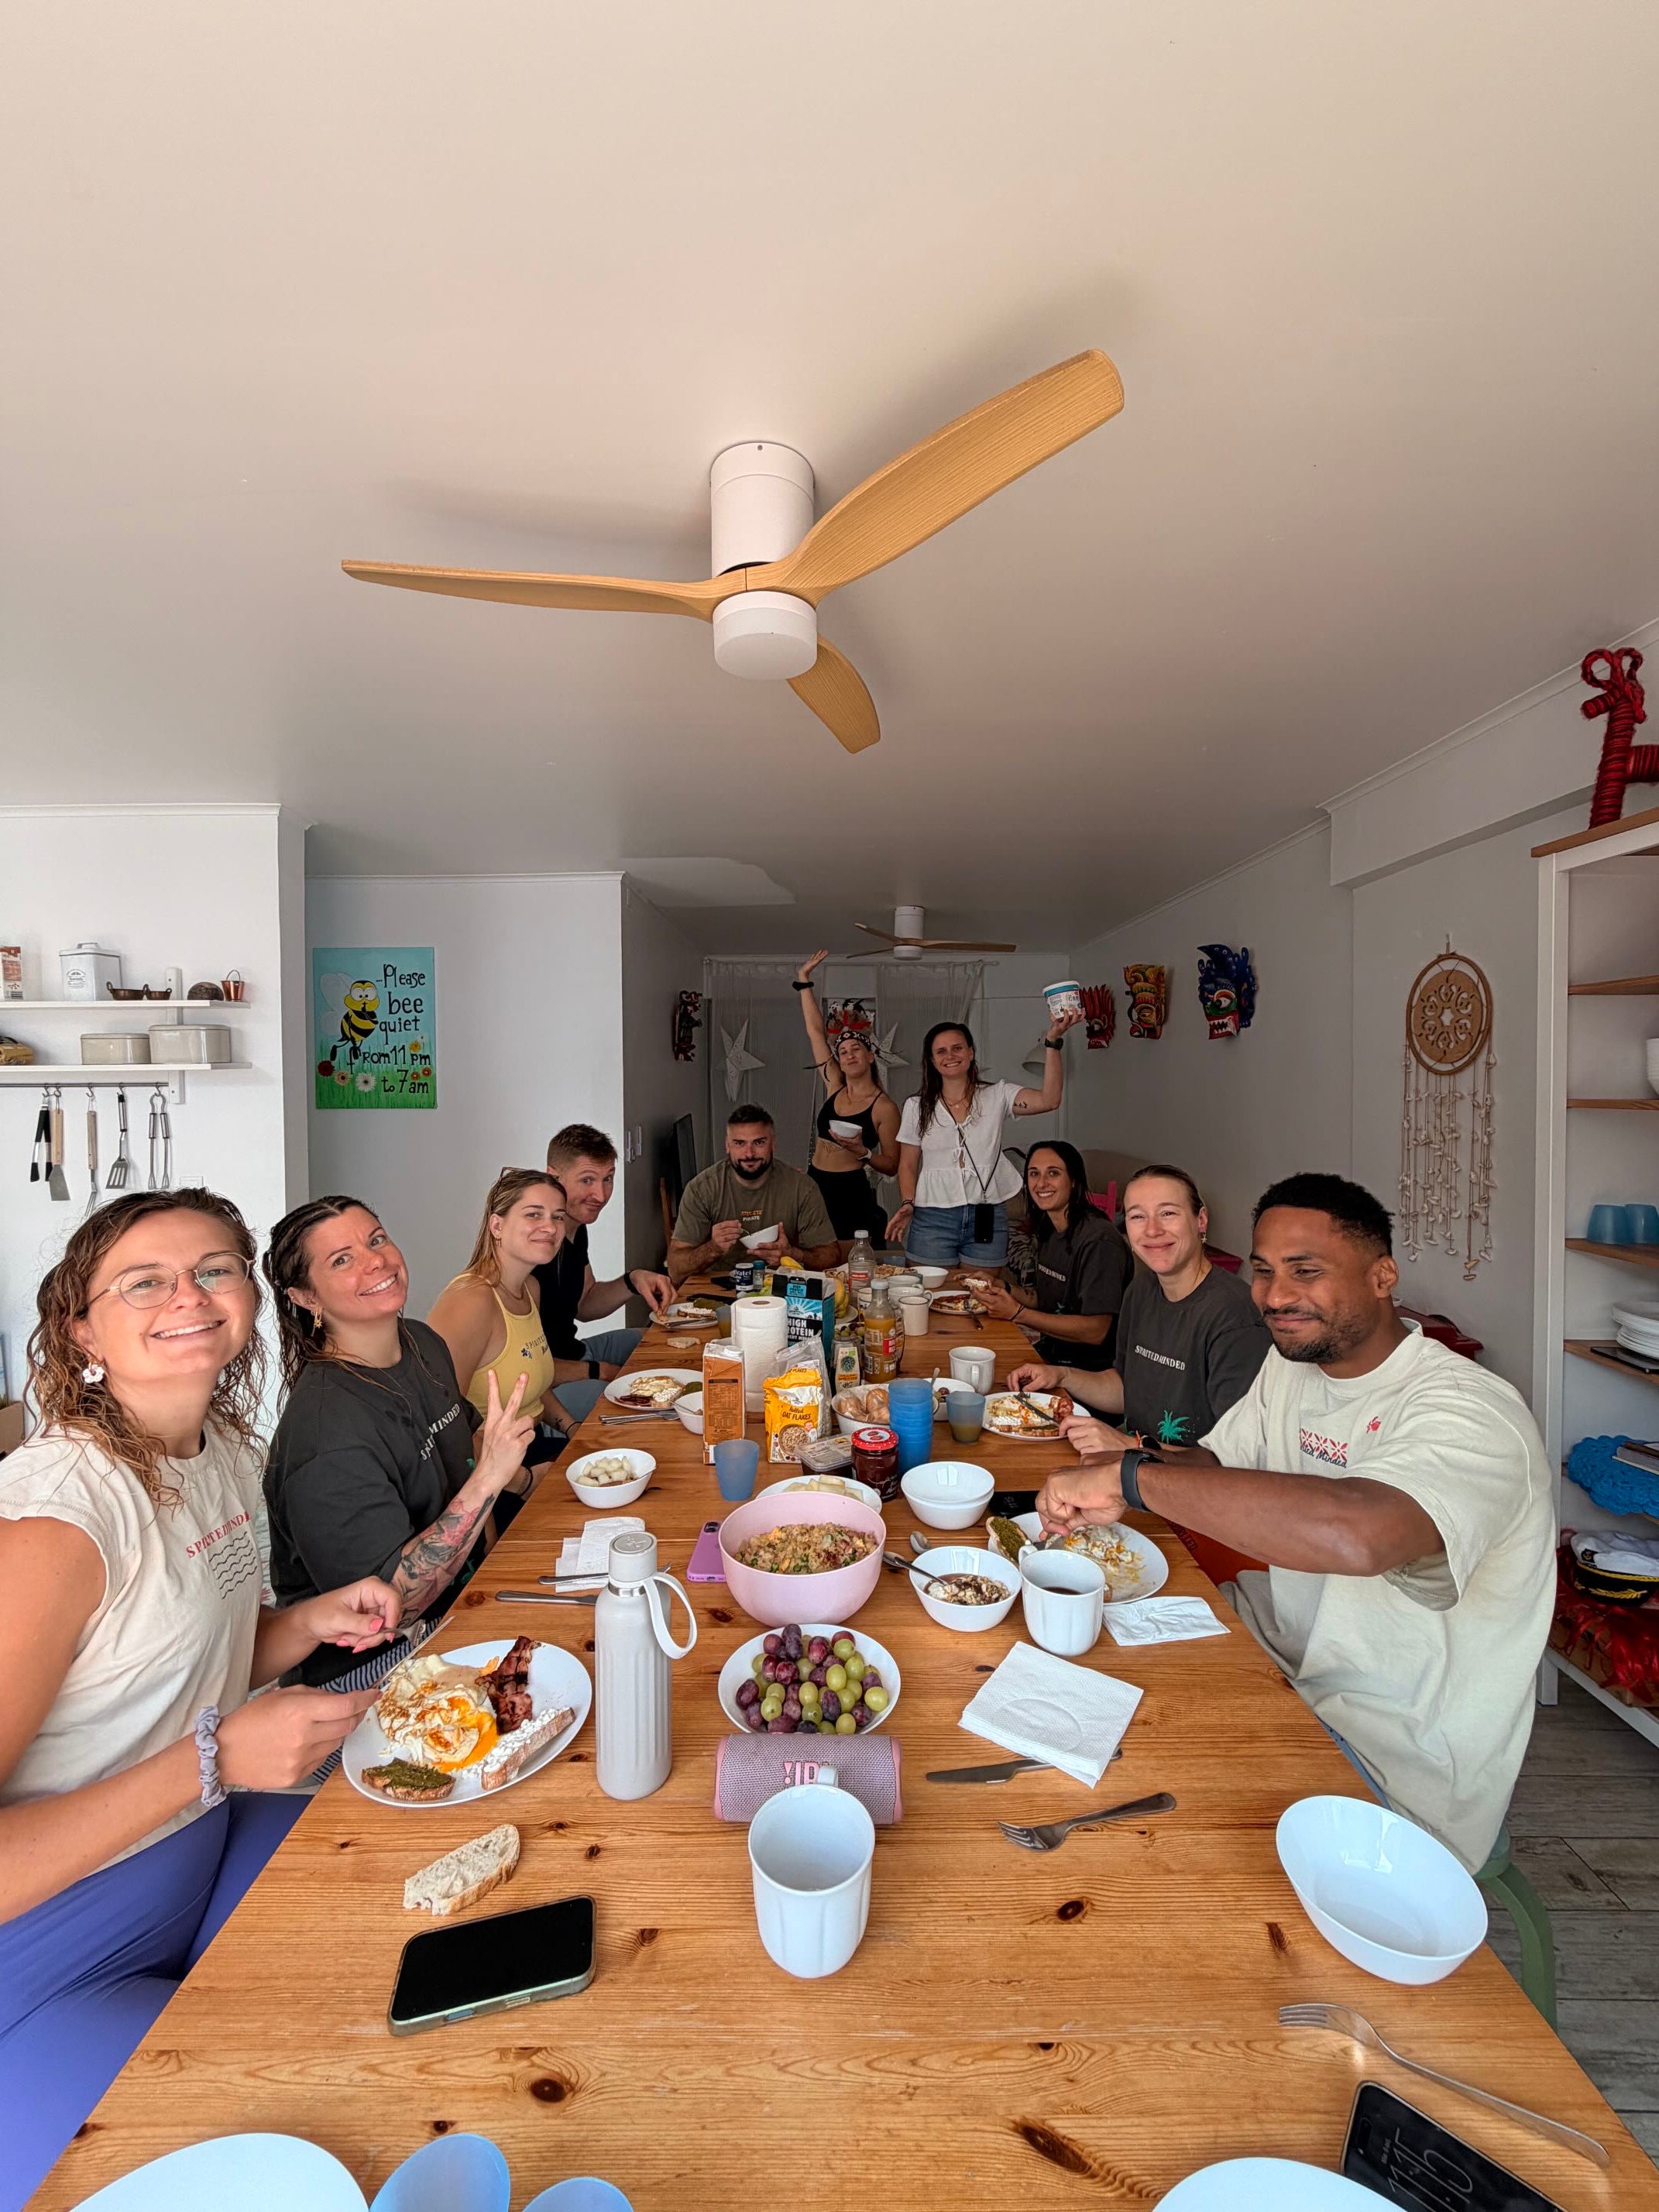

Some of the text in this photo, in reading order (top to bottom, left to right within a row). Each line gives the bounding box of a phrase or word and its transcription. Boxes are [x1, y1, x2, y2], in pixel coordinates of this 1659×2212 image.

[387, 991, 424, 1015] bee
[379, 1015, 421, 1045] quiet
[410, 1053, 431, 1066] pm
[380, 1069, 429, 1094] to 7 am
